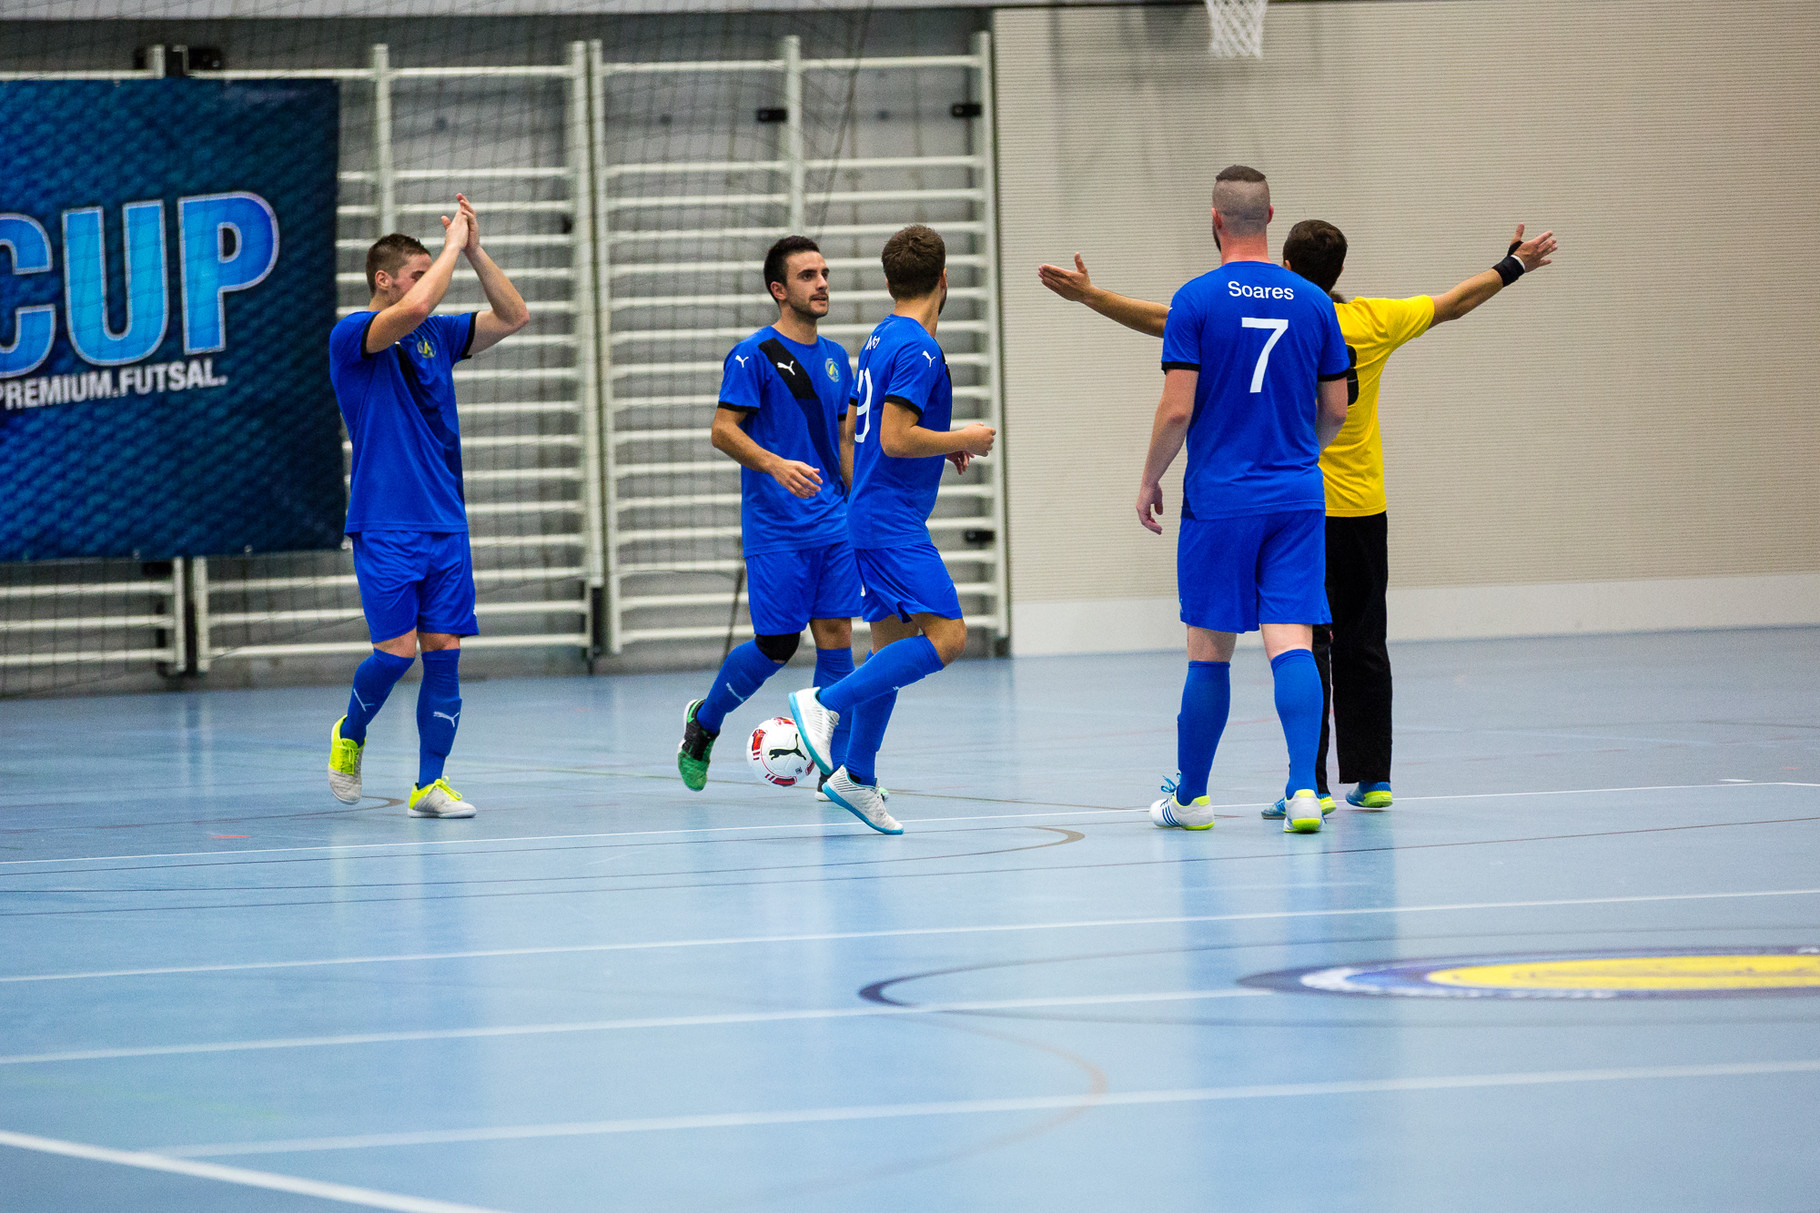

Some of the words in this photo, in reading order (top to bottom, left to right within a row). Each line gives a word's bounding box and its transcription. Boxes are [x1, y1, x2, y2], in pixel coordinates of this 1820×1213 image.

[1227, 280, 1294, 300] Soares
[1241, 317, 1289, 393] 7
[0, 358, 228, 411] REMIUM.FUTSAL.
